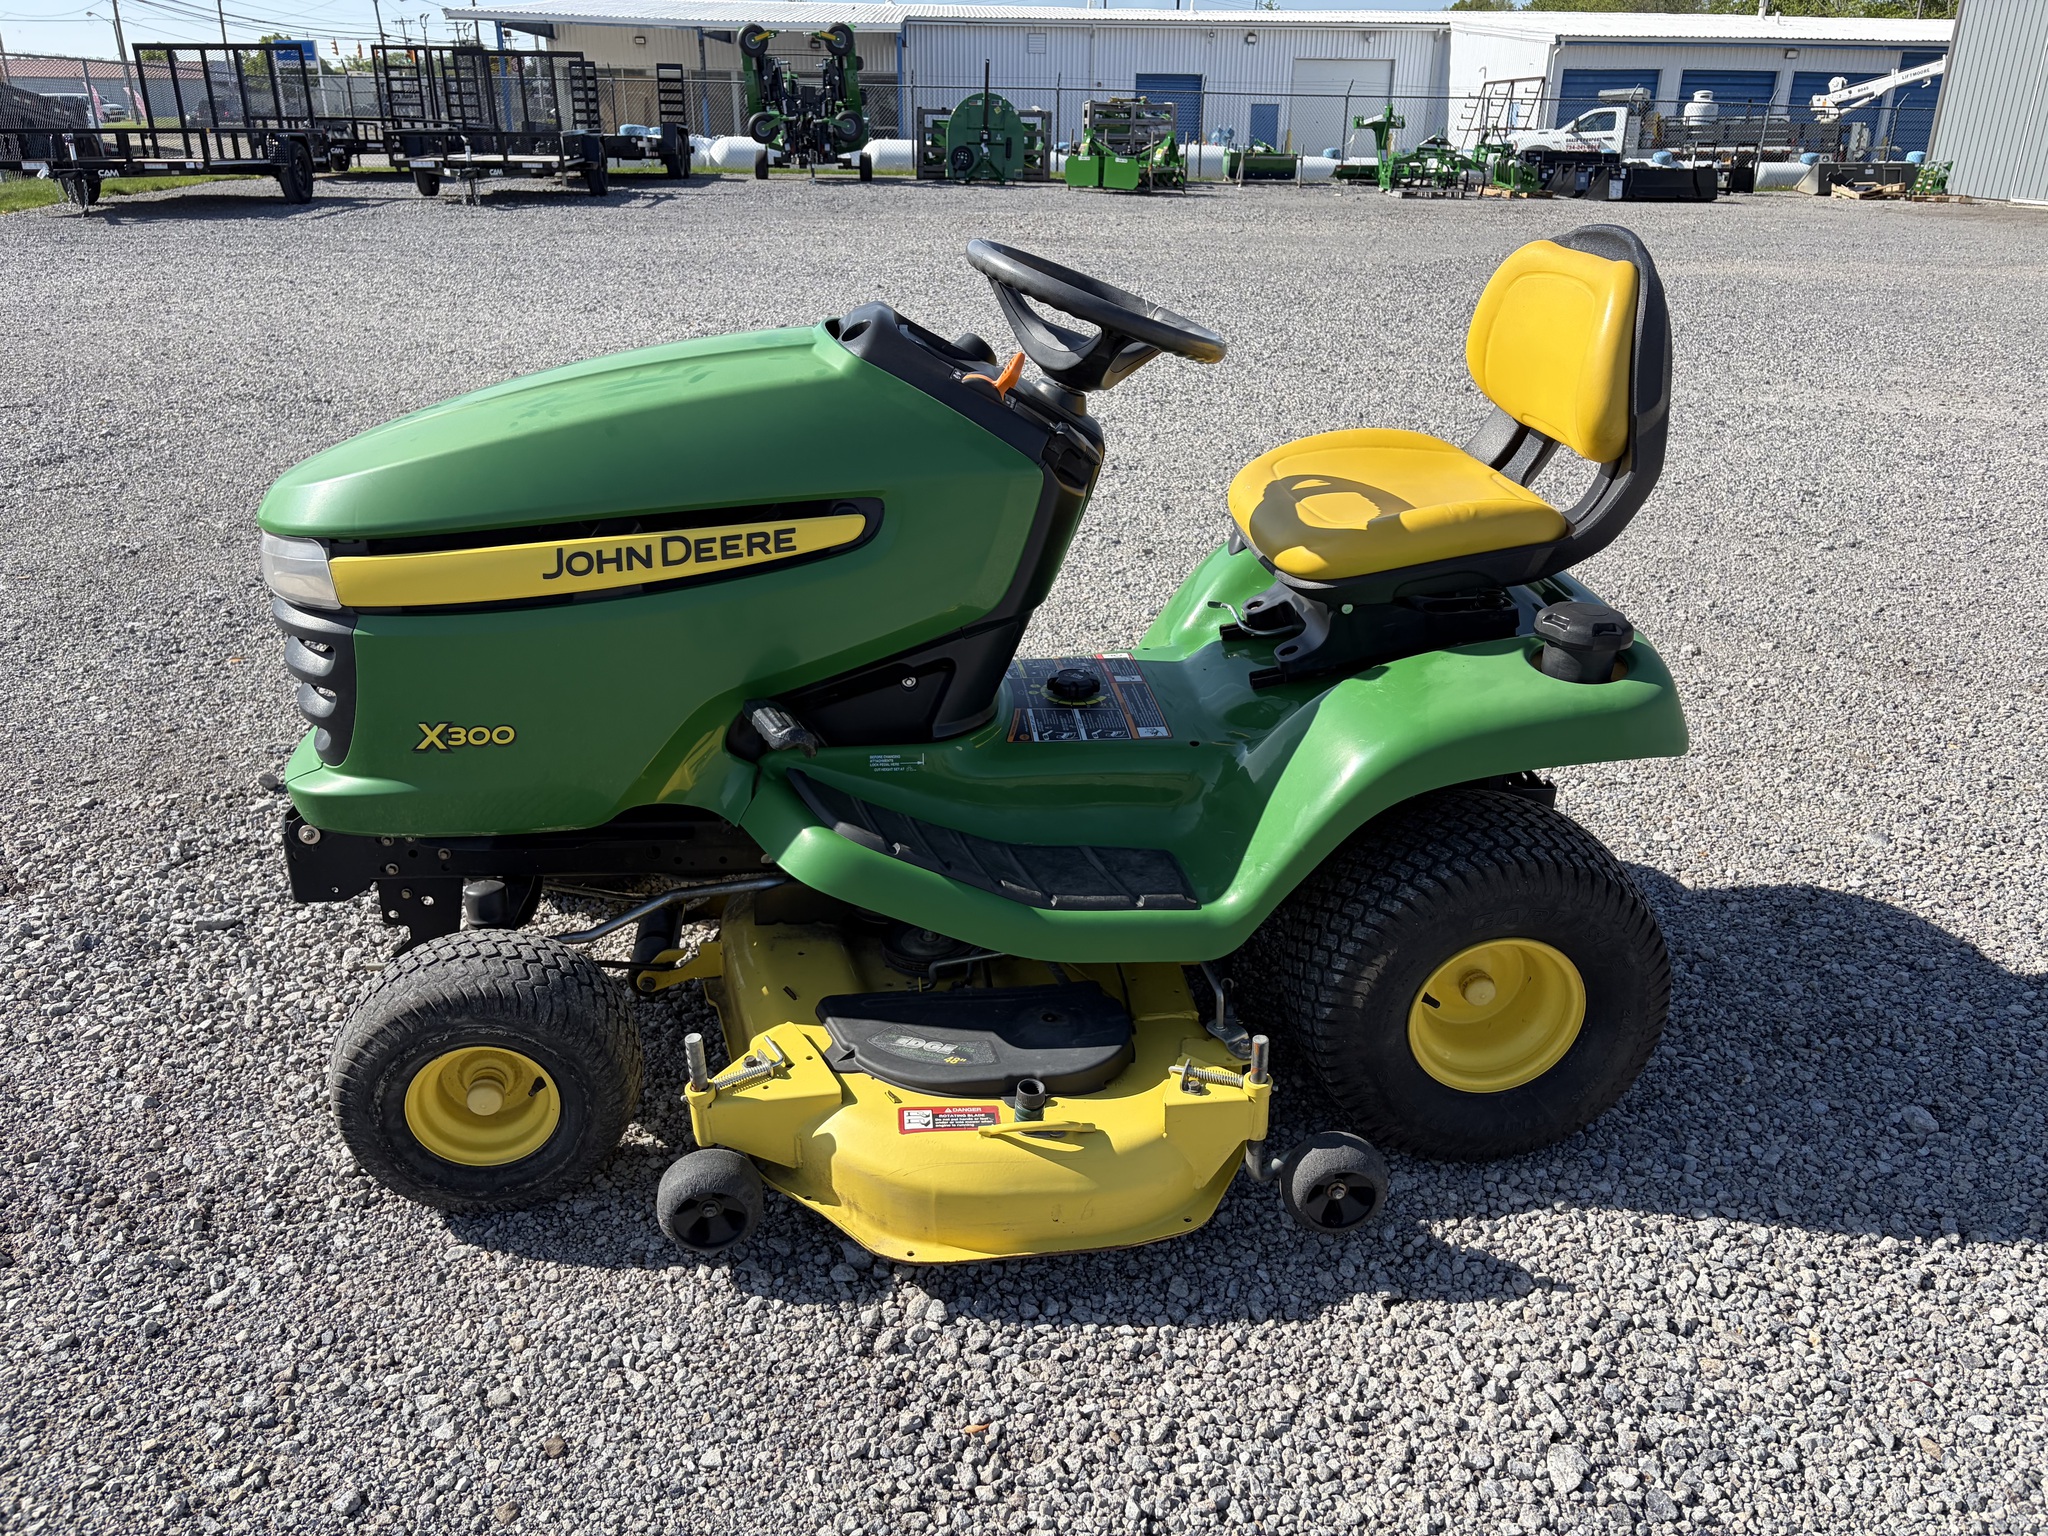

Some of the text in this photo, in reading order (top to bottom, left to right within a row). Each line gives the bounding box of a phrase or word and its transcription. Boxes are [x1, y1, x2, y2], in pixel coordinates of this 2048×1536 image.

[1901, 68, 1931, 80] LIFTMOORE
[98, 169, 119, 177] CAM
[489, 168, 504, 176] CAM
[542, 527, 797, 580] JOHN DEERE
[412, 722, 517, 753] X300
[891, 1035, 958, 1054] EDGE
